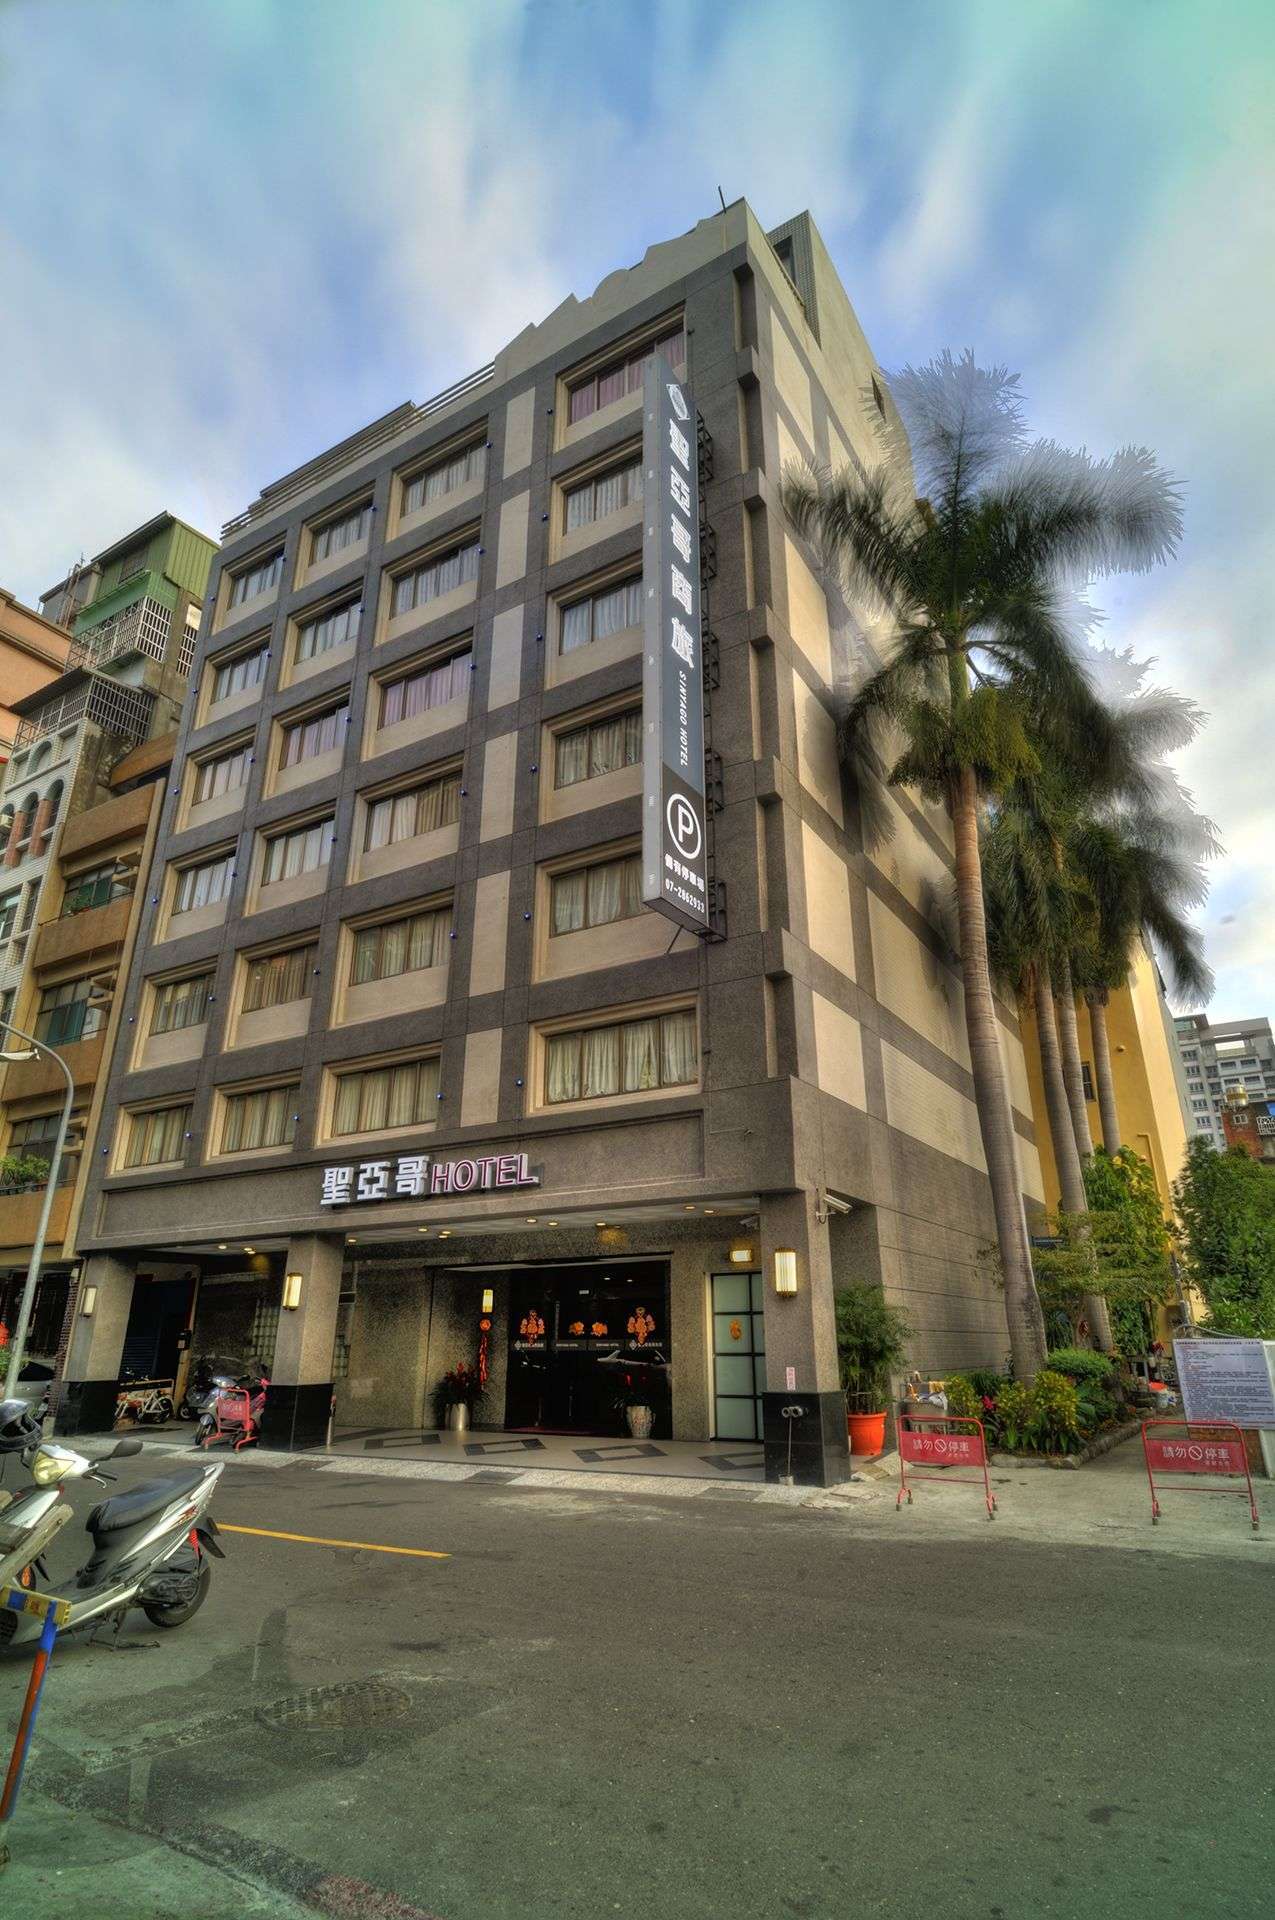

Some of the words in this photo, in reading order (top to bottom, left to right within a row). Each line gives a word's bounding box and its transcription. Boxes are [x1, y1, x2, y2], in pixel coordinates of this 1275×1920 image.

[679, 670, 688, 726] SINYAGO
[680, 727, 689, 767] HOTEL
[320, 1155, 431, 1206] 聖亞哥
[430, 1152, 539, 1194] HOTEL
